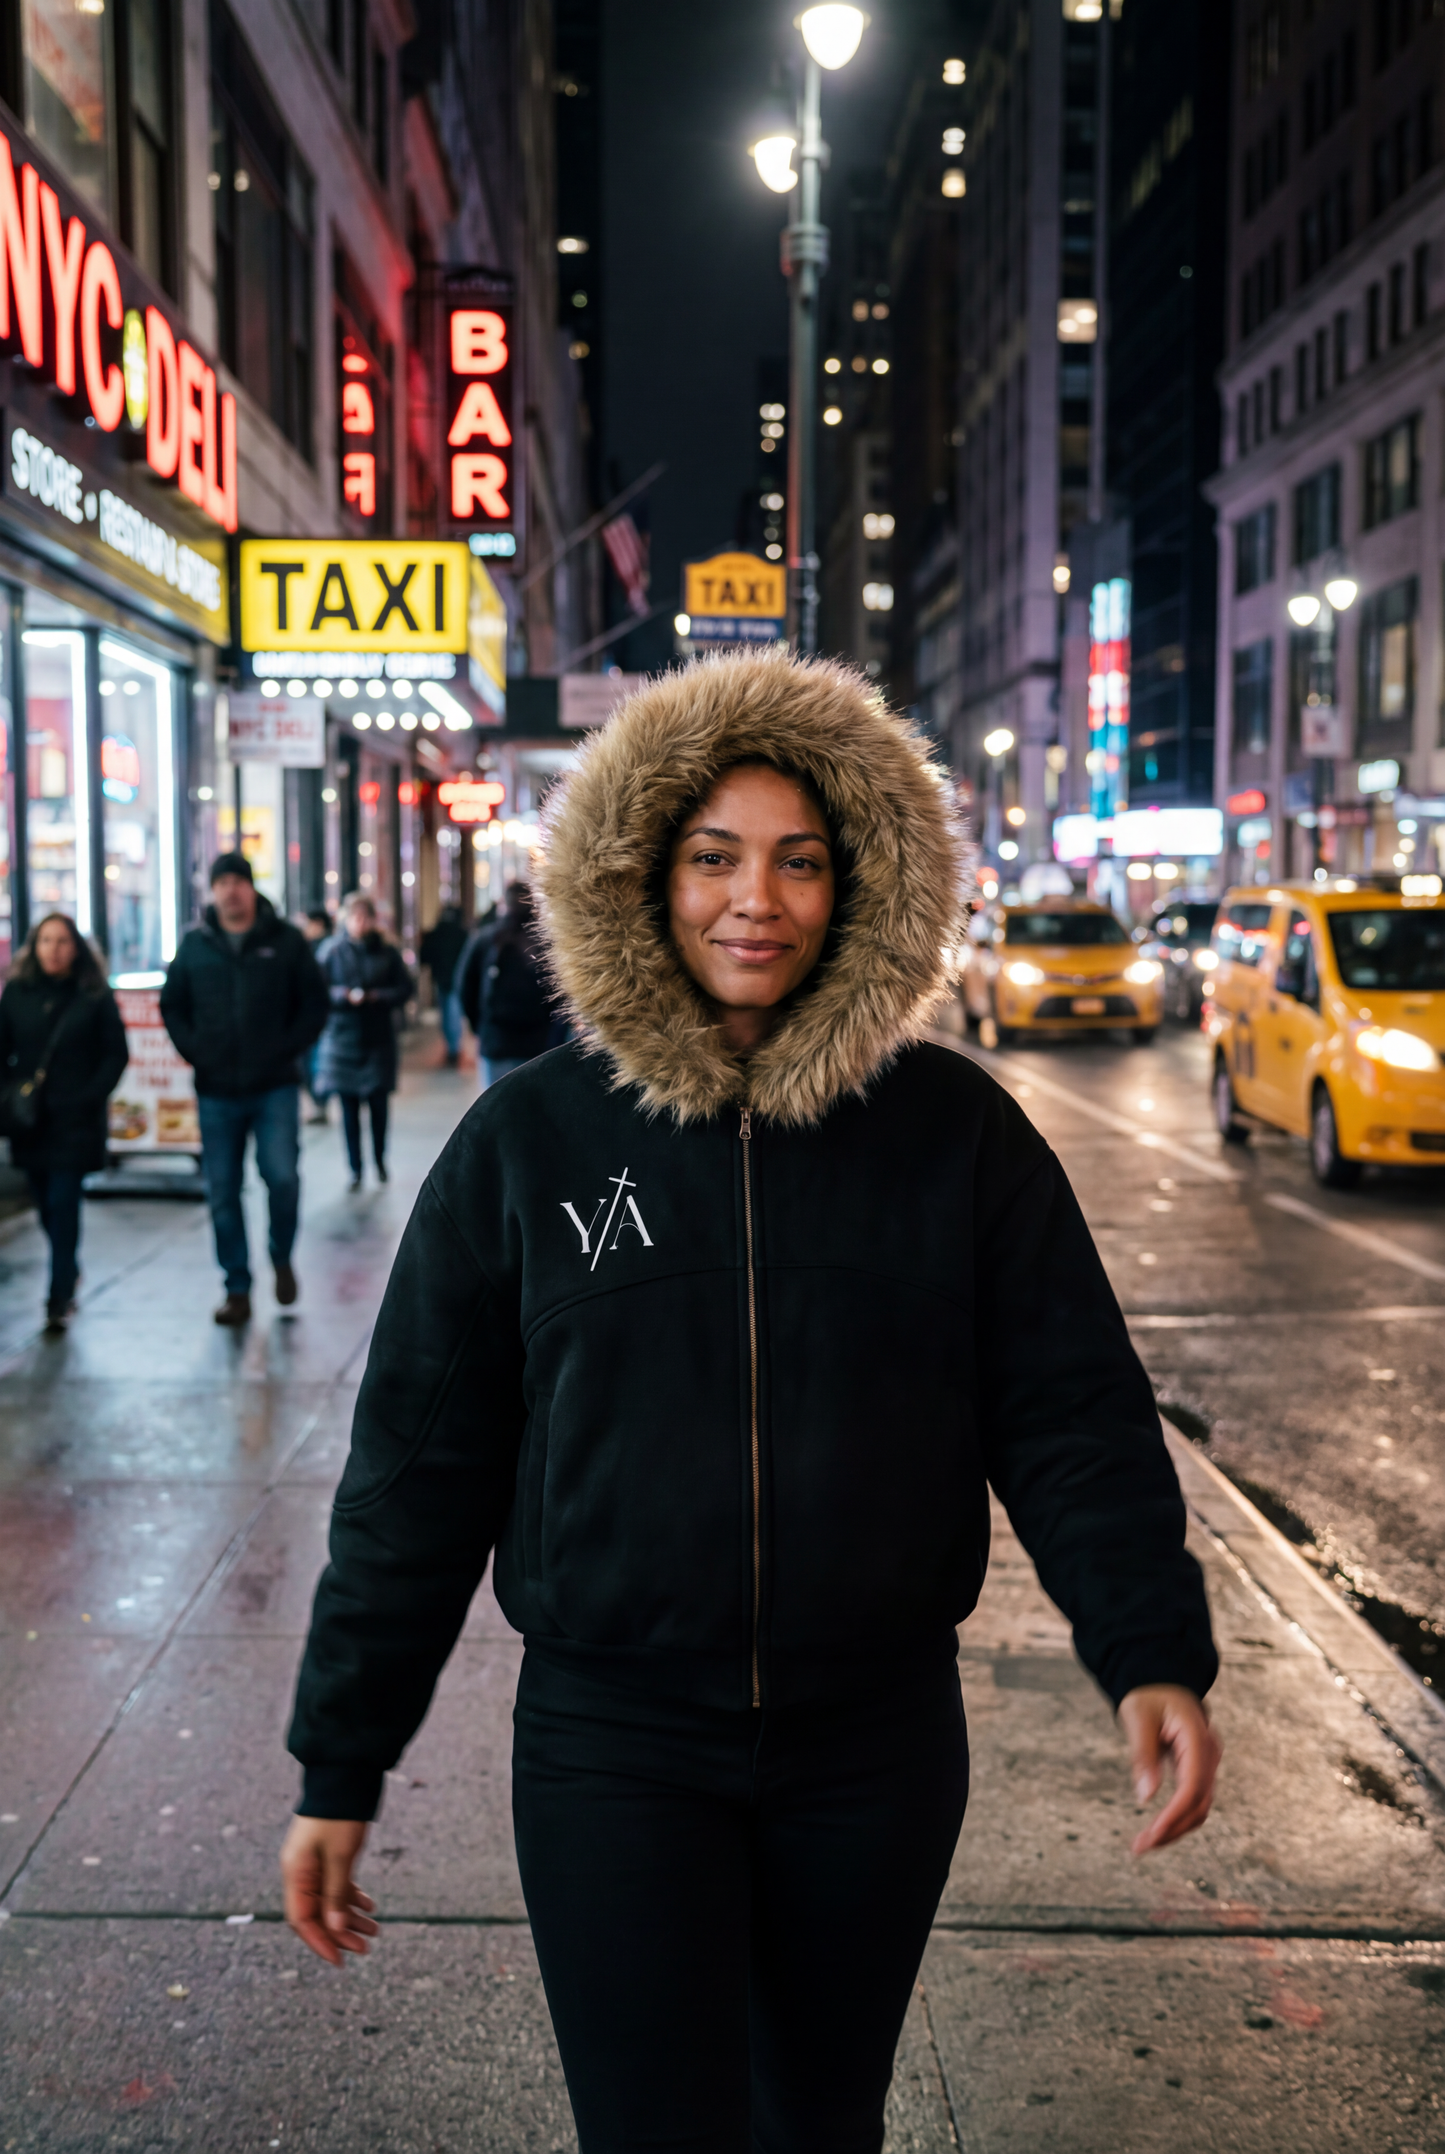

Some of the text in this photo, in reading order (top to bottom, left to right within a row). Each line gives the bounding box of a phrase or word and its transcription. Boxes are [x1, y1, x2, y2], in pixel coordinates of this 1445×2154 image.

[0, 131, 238, 533] NYC DELI
[447, 310, 512, 518] BAR
[261, 563, 444, 631] TAXI
[700, 577, 775, 606] TAXI
